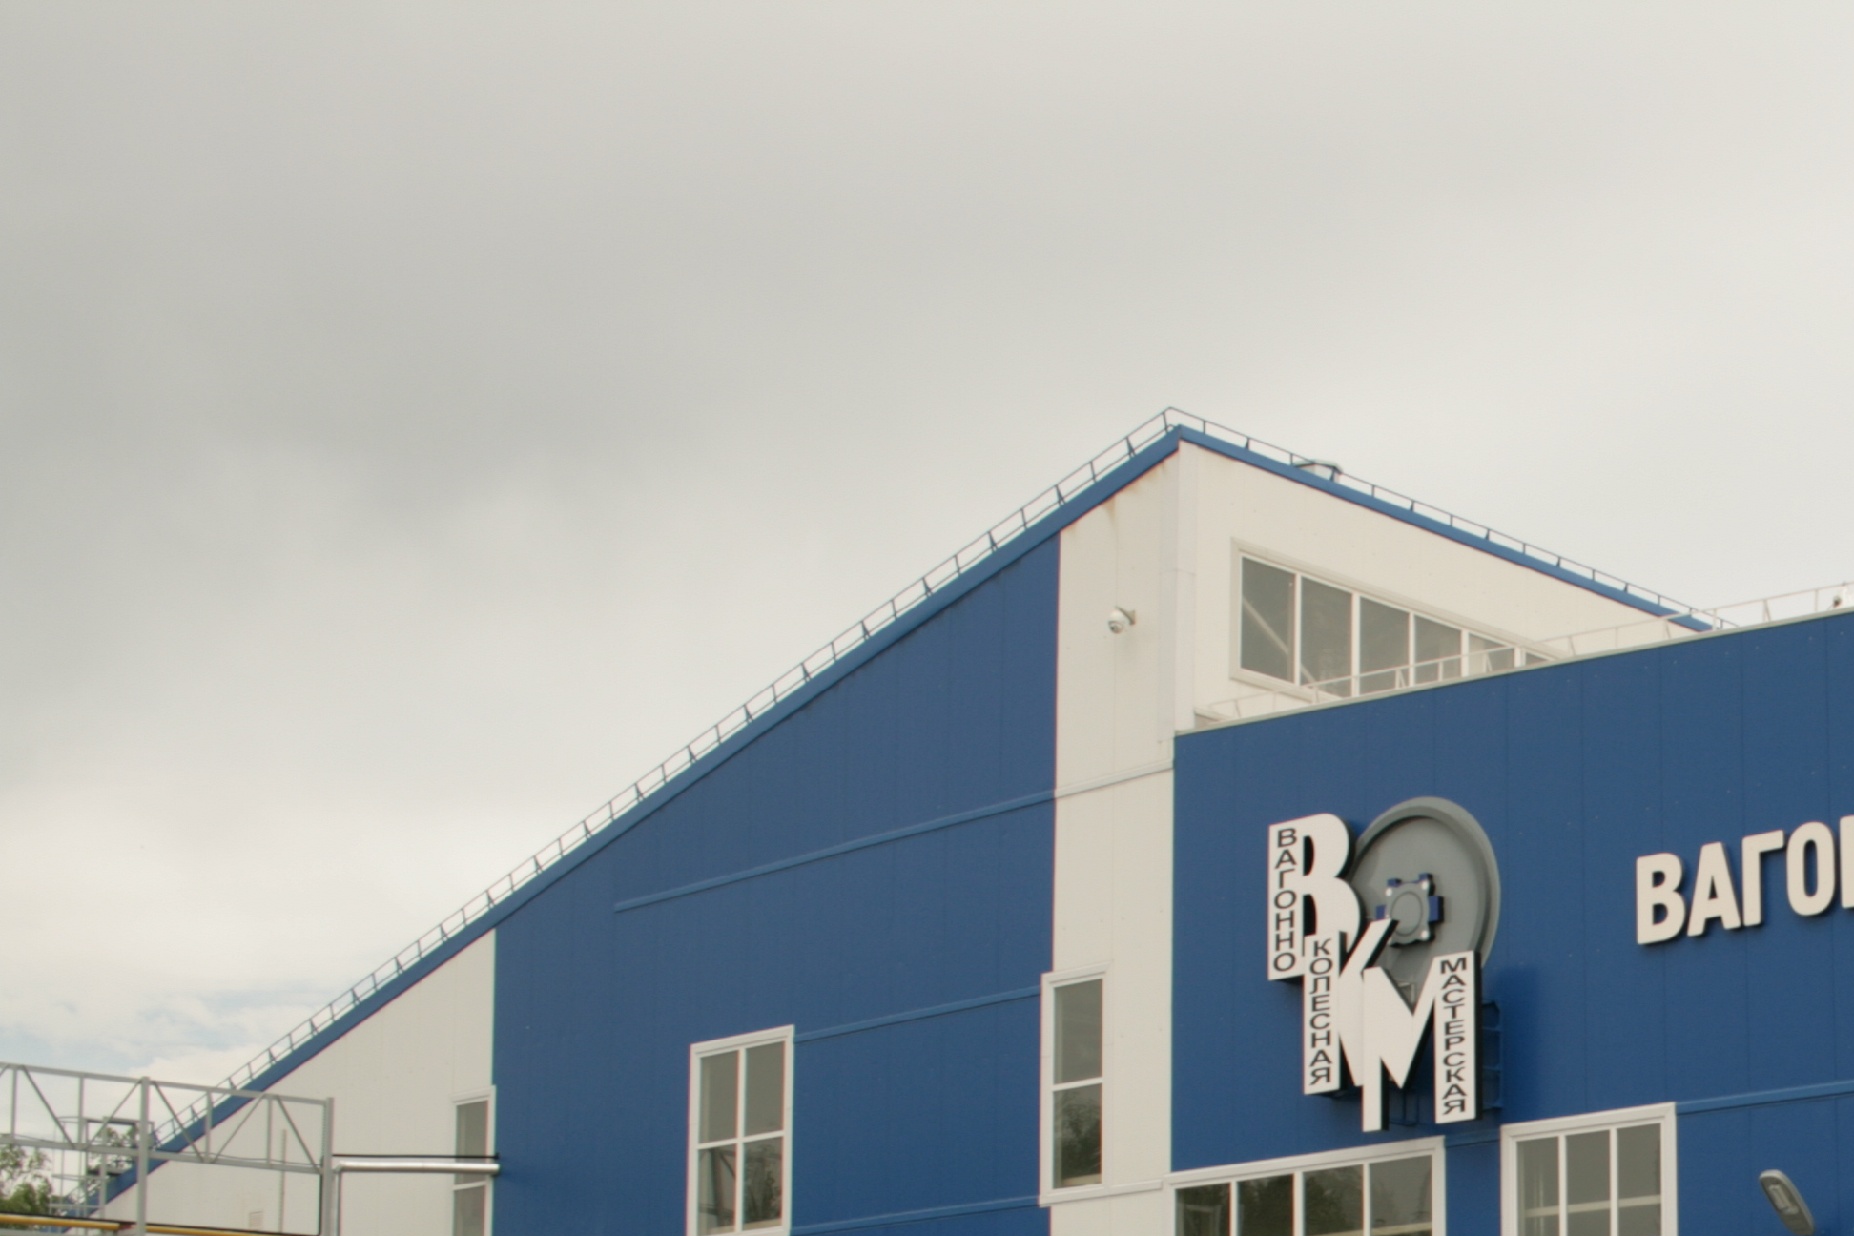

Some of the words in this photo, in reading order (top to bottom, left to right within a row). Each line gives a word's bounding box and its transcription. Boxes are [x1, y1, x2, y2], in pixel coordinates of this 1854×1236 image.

[1273, 828, 1297, 972] ВАГОННО
[1309, 938, 1332, 1085] КОЛЕСНАЯ
[1440, 957, 1467, 1115] МАСТЕРСКАЯ
